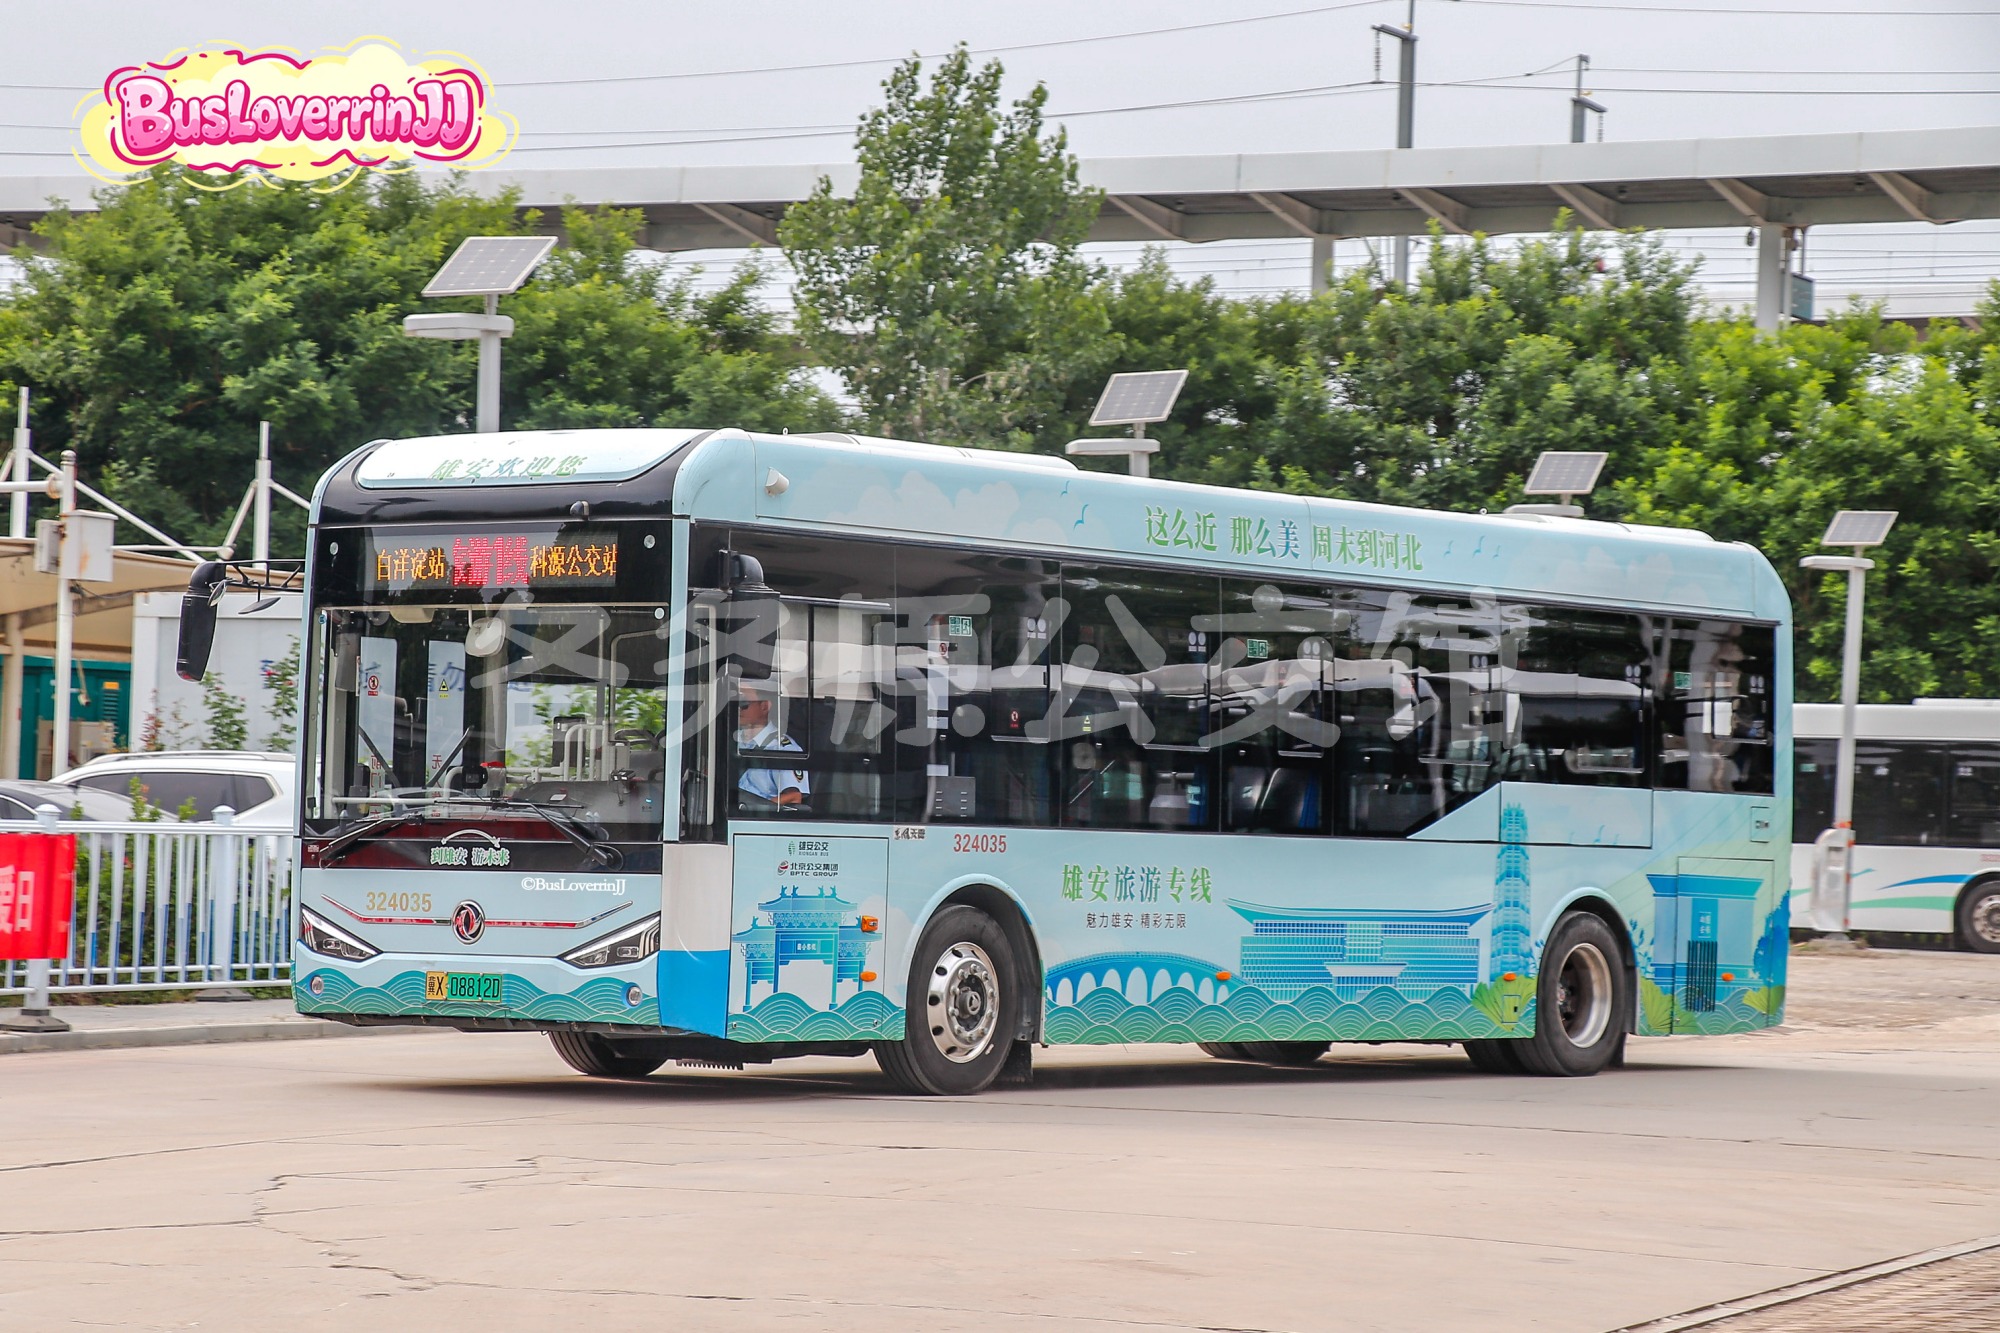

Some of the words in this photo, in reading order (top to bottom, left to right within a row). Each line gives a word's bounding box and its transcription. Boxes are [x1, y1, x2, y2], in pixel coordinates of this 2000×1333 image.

[430, 455, 588, 481] 雄安欢迎您
[1145, 504, 1218, 552] 这么近
[1230, 516, 1300, 560] 那么美
[1312, 524, 1424, 571] 周末到河北
[376, 547, 446, 581] 白洋淀站
[529, 543, 617, 578] 科源公交站
[798, 841, 829, 851] 雄安公交
[954, 834, 1007, 853] 324035
[430, 847, 467, 866] 到雄安
[471, 847, 510, 866] 游未来
[790, 862, 839, 872] 北京公交集团
[1061, 864, 1213, 903] 雄安旅游专线
[366, 891, 432, 912] 324035
